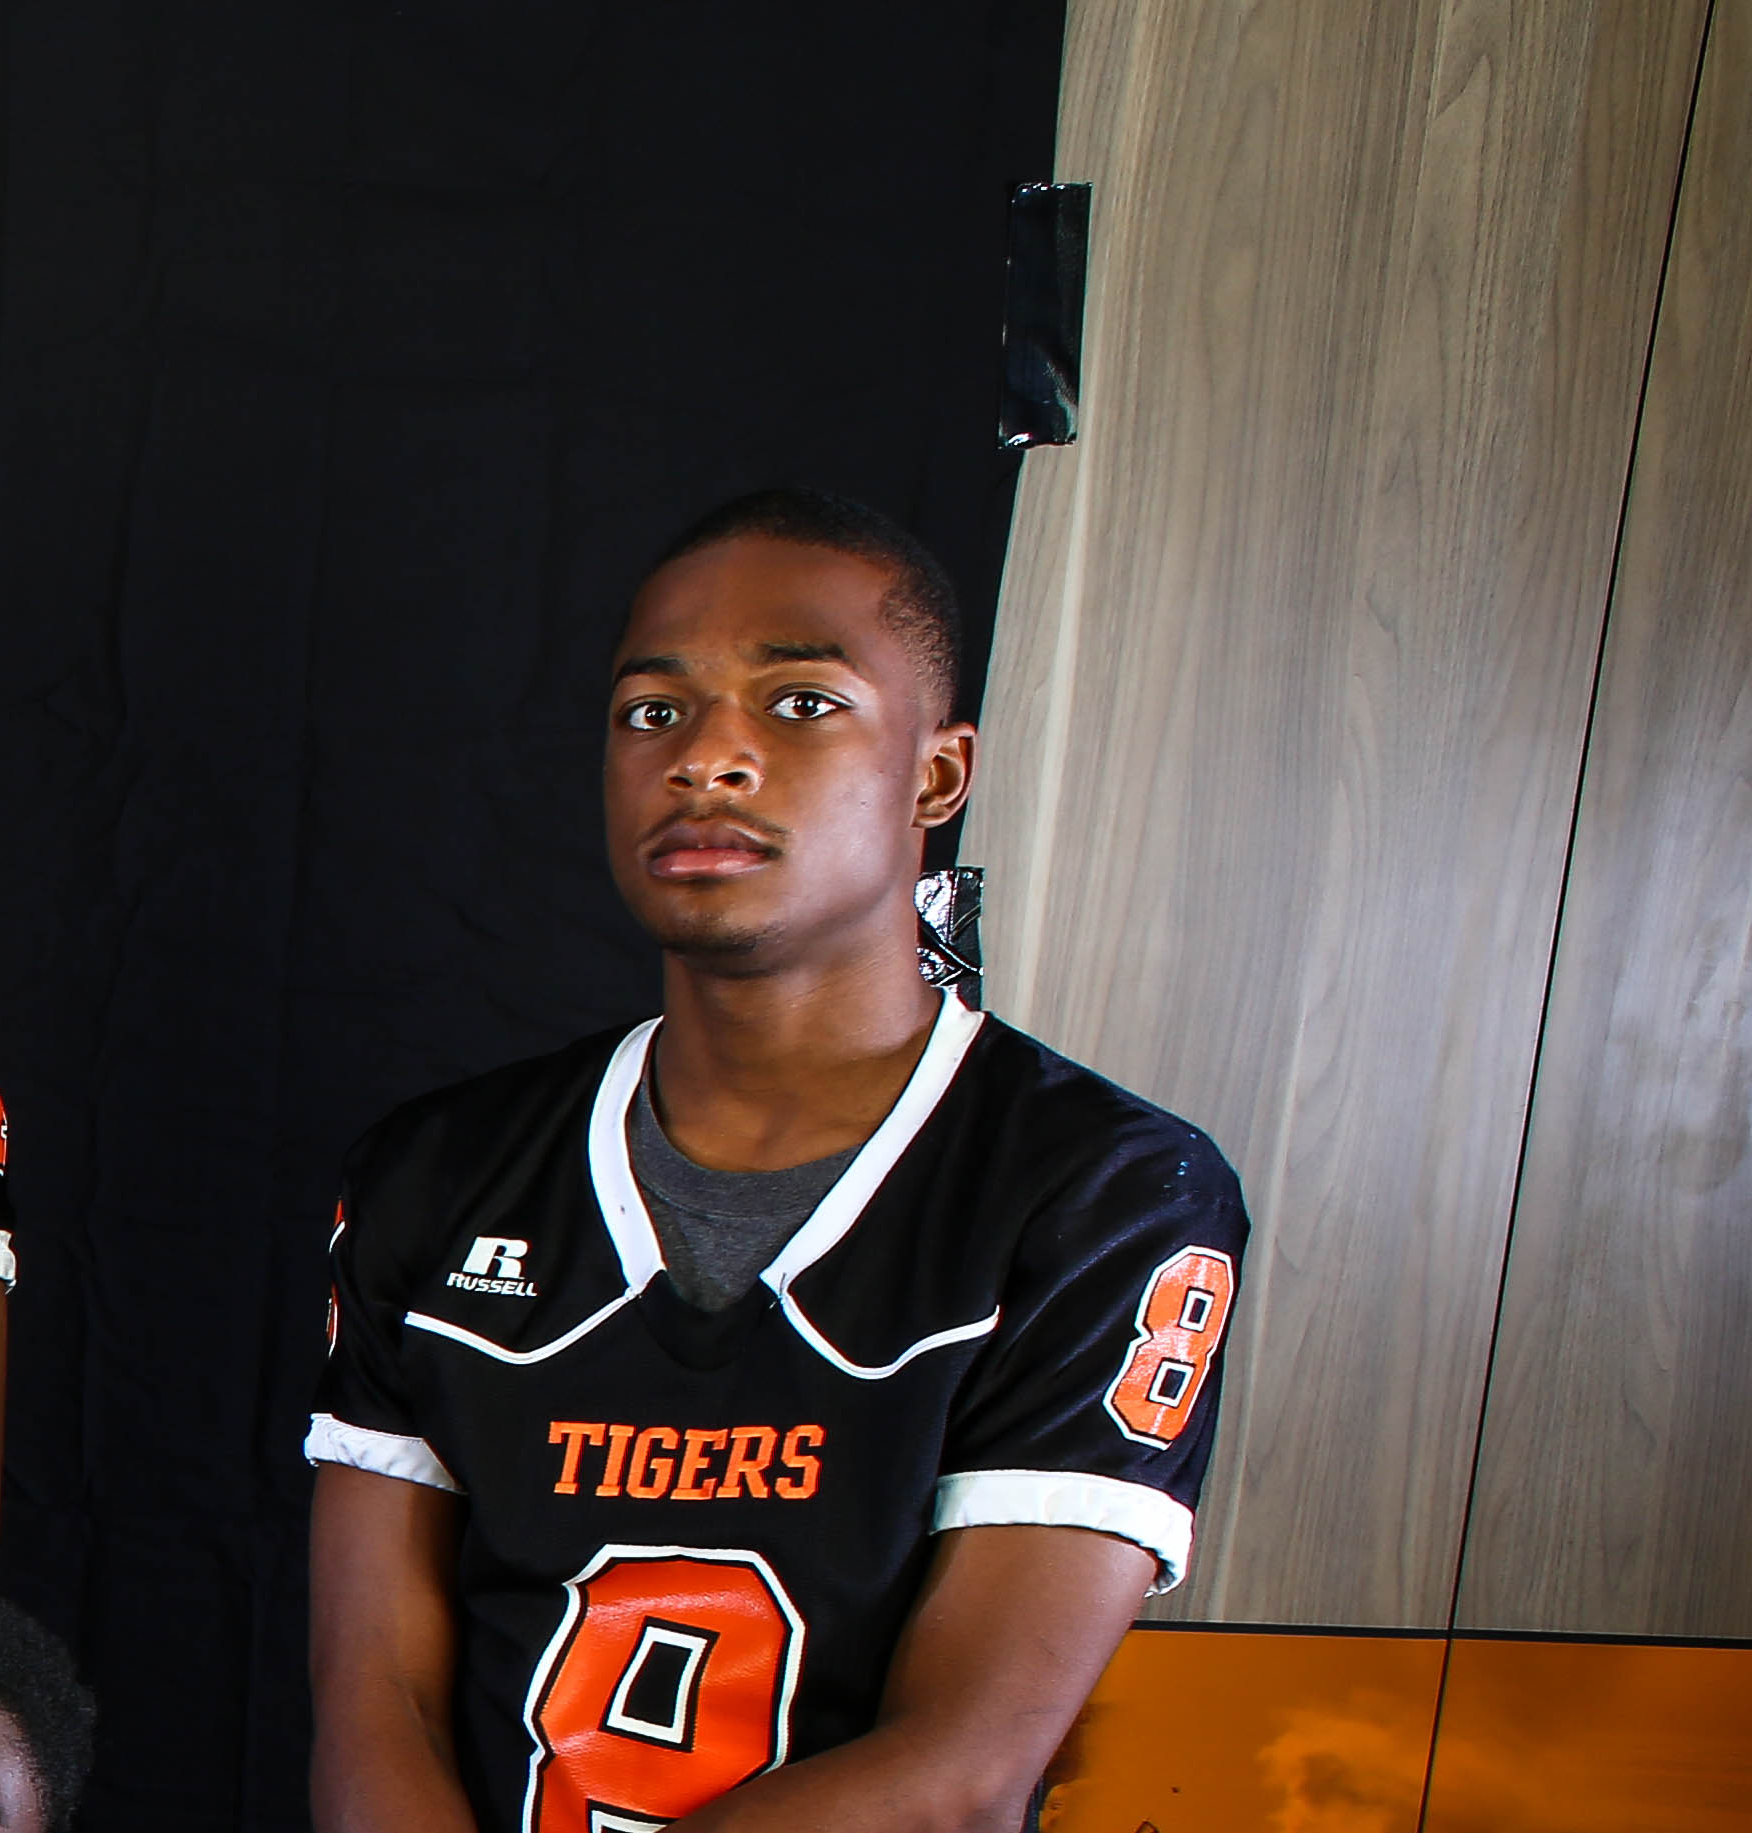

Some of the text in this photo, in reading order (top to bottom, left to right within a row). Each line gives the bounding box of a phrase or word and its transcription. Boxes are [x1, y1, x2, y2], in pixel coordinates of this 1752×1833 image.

[446, 1272, 538, 1297] RUSSELL
[1103, 1245, 1235, 1450] 8
[549, 1422, 825, 1501] TIGERS
